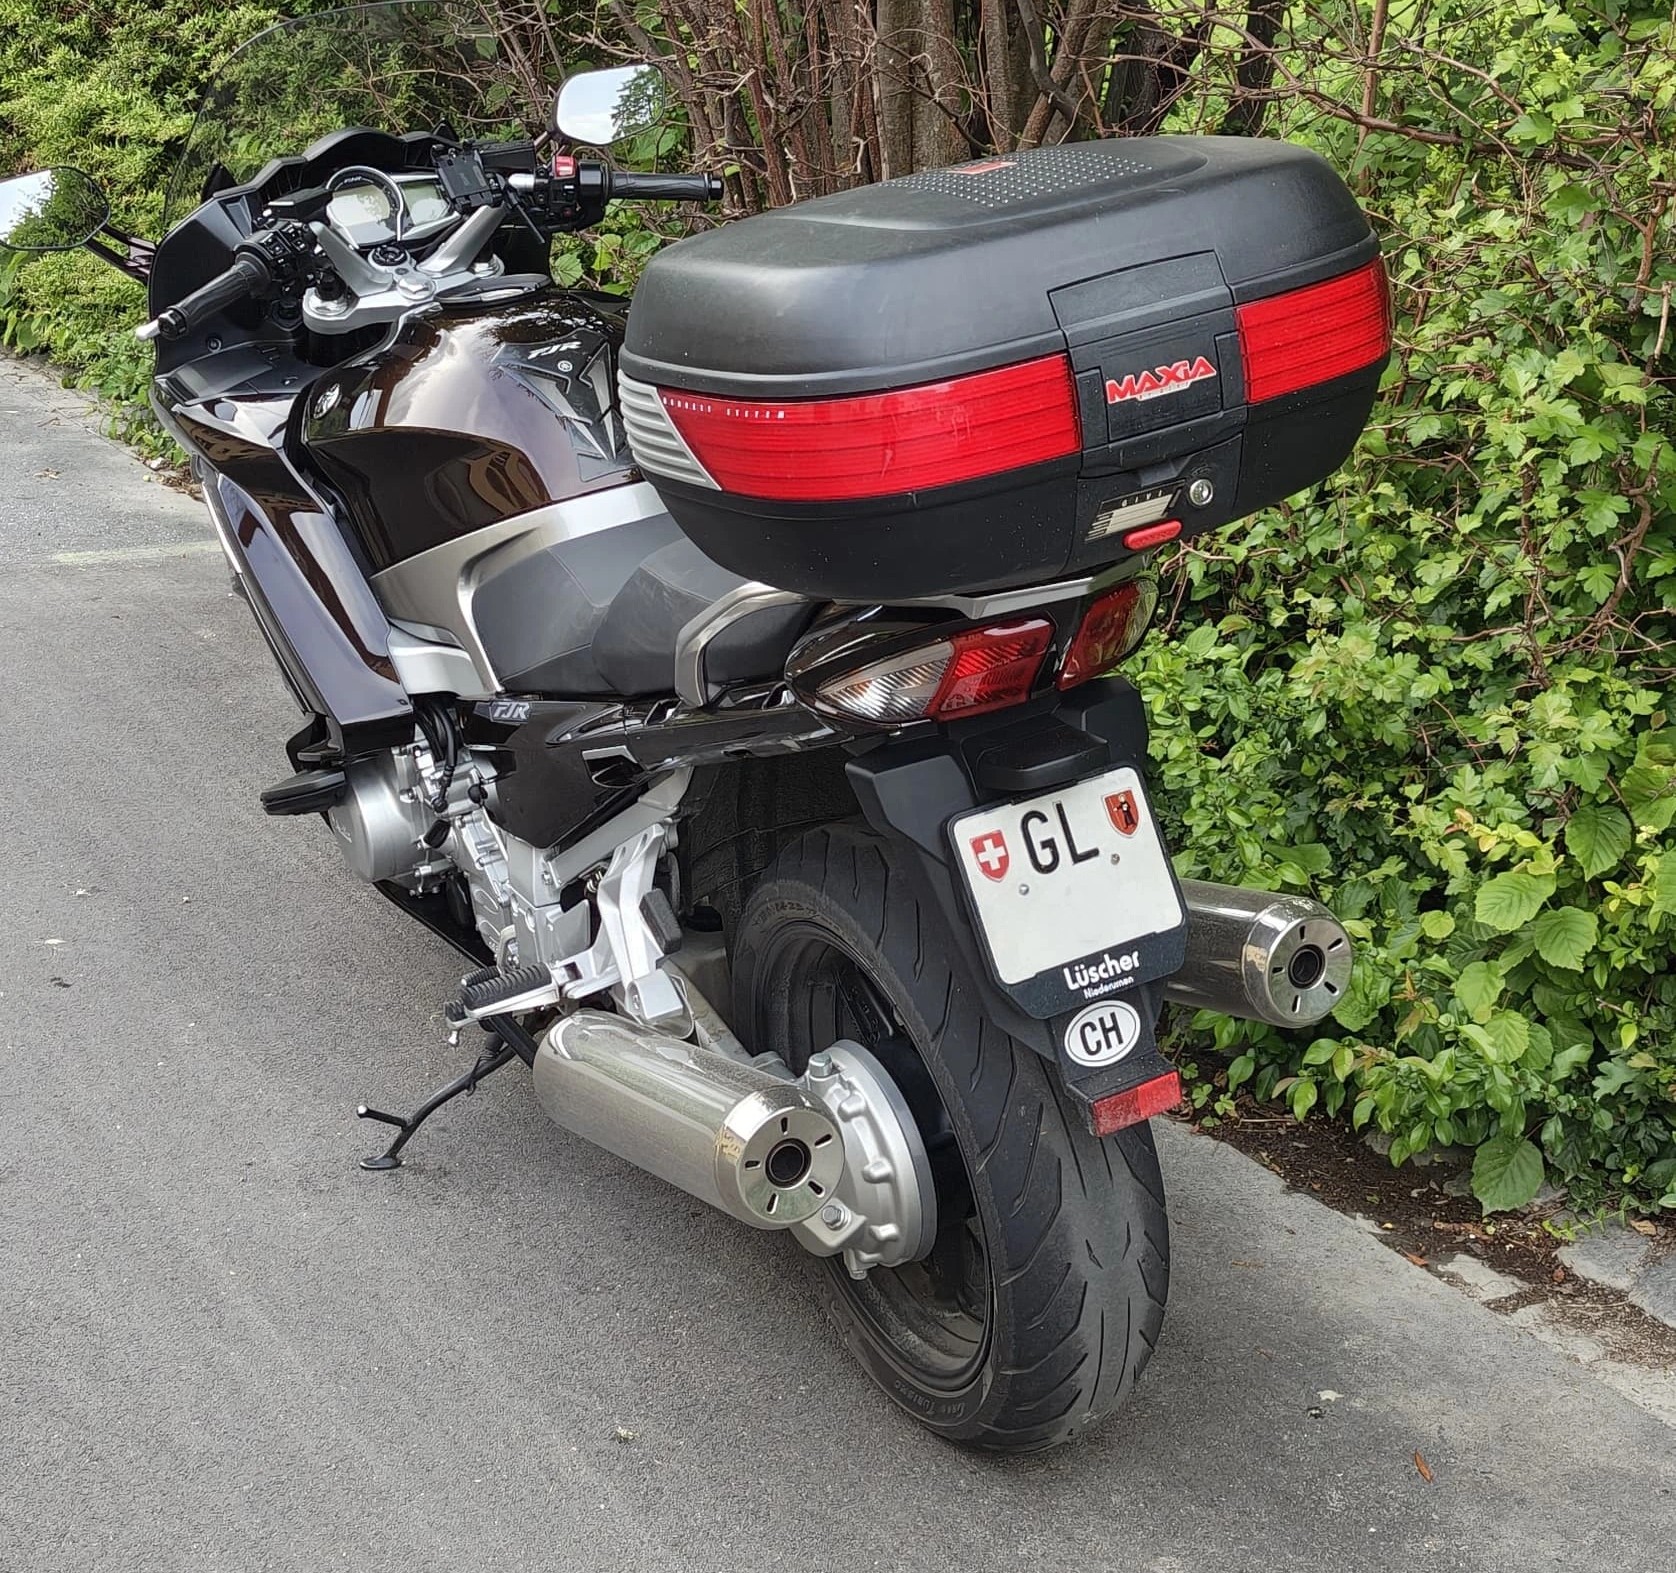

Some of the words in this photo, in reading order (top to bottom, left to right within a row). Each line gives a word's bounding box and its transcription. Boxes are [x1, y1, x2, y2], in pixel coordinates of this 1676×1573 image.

[493, 701, 530, 720] FJR
[1019, 802, 1100, 876] GL
[1063, 951, 1140, 990] Lüscher
[1079, 1011, 1125, 1057] CH
